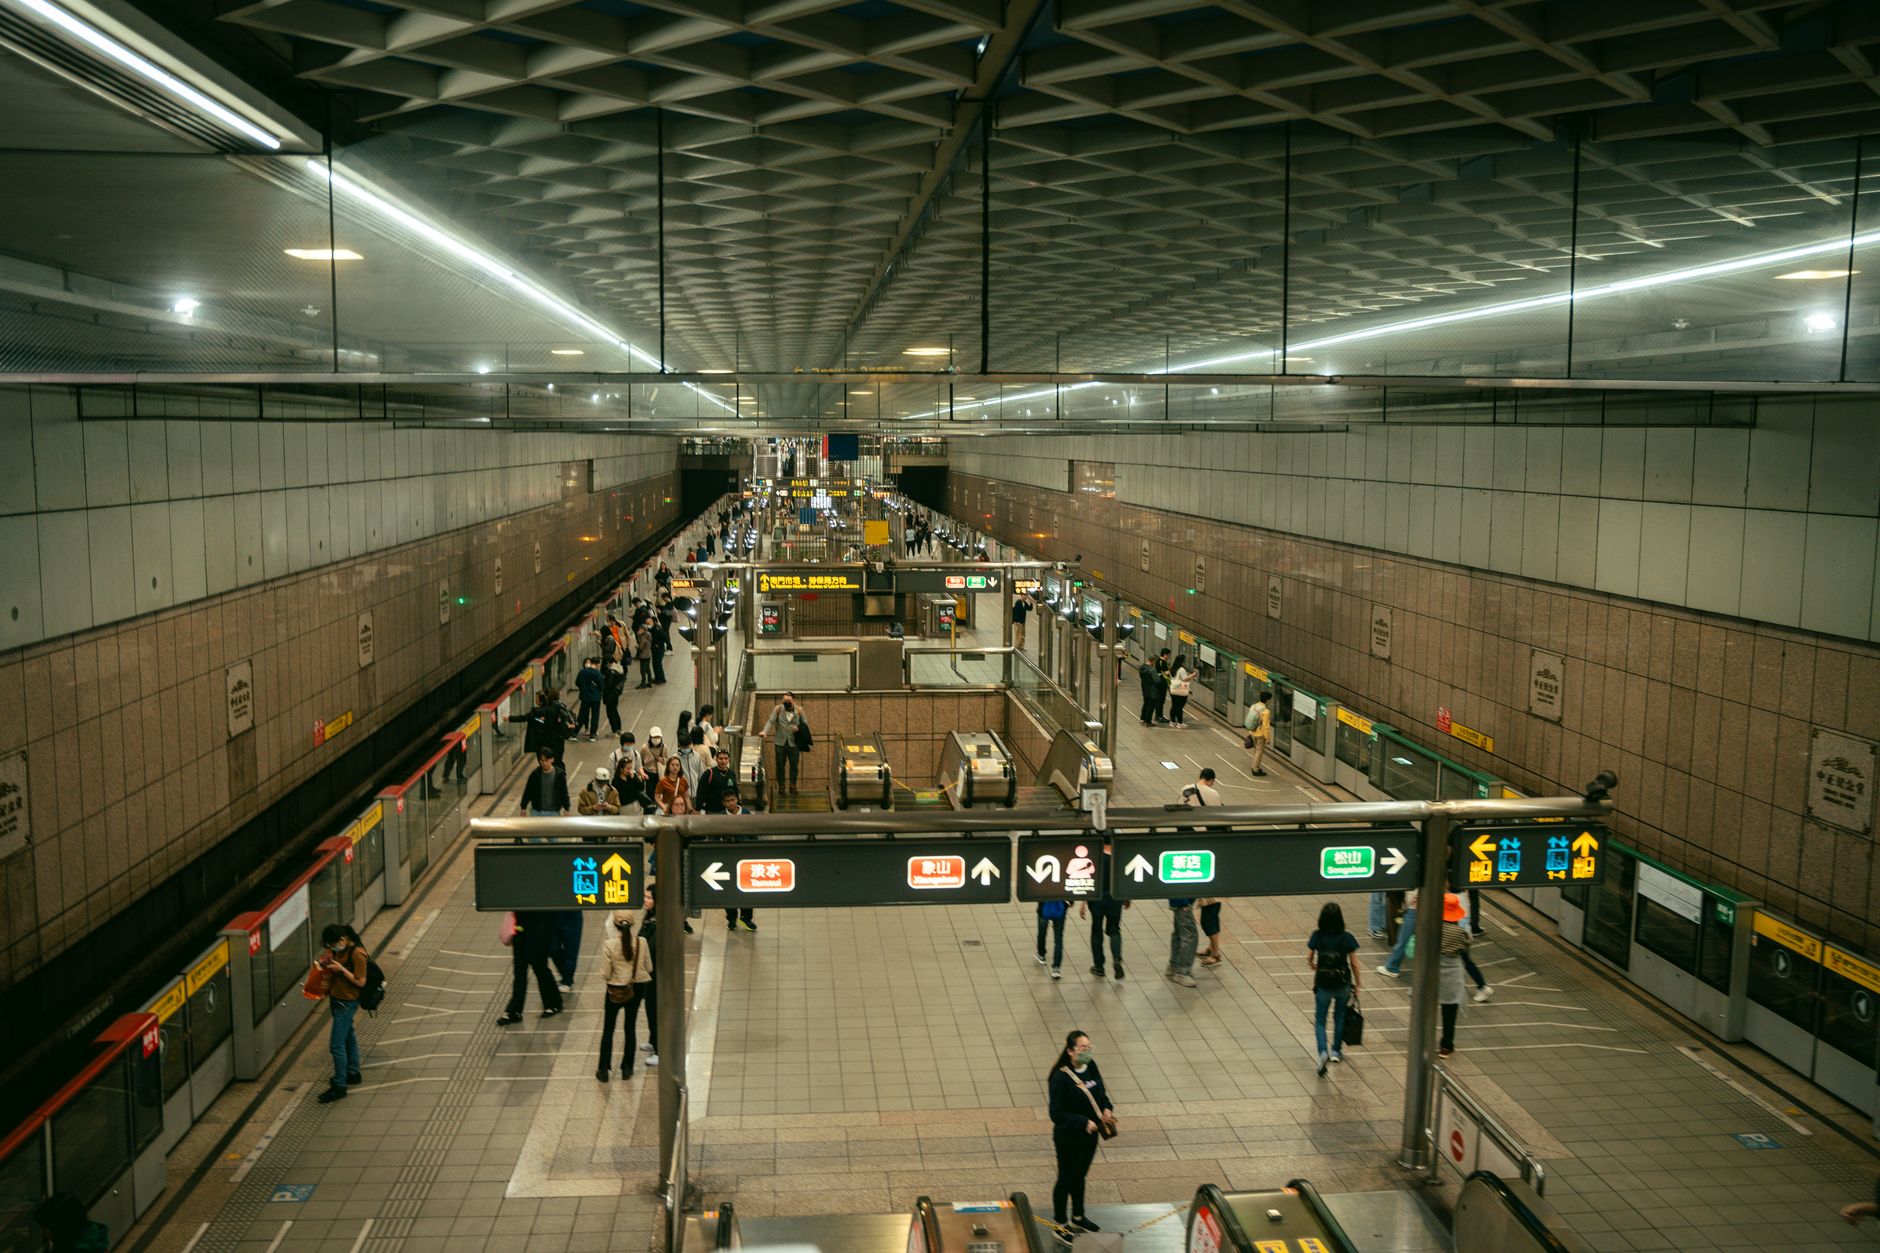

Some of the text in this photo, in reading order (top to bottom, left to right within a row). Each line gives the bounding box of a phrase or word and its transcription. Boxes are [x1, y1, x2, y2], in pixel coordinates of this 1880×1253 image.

[1172, 855, 1201, 869] 新店
[1334, 851, 1361, 864] 松山
[750, 863, 781, 878] 淡水
[922, 860, 951, 874] 象山
[1498, 871, 1519, 882] 5-7
[1546, 870, 1567, 880] 1-4
